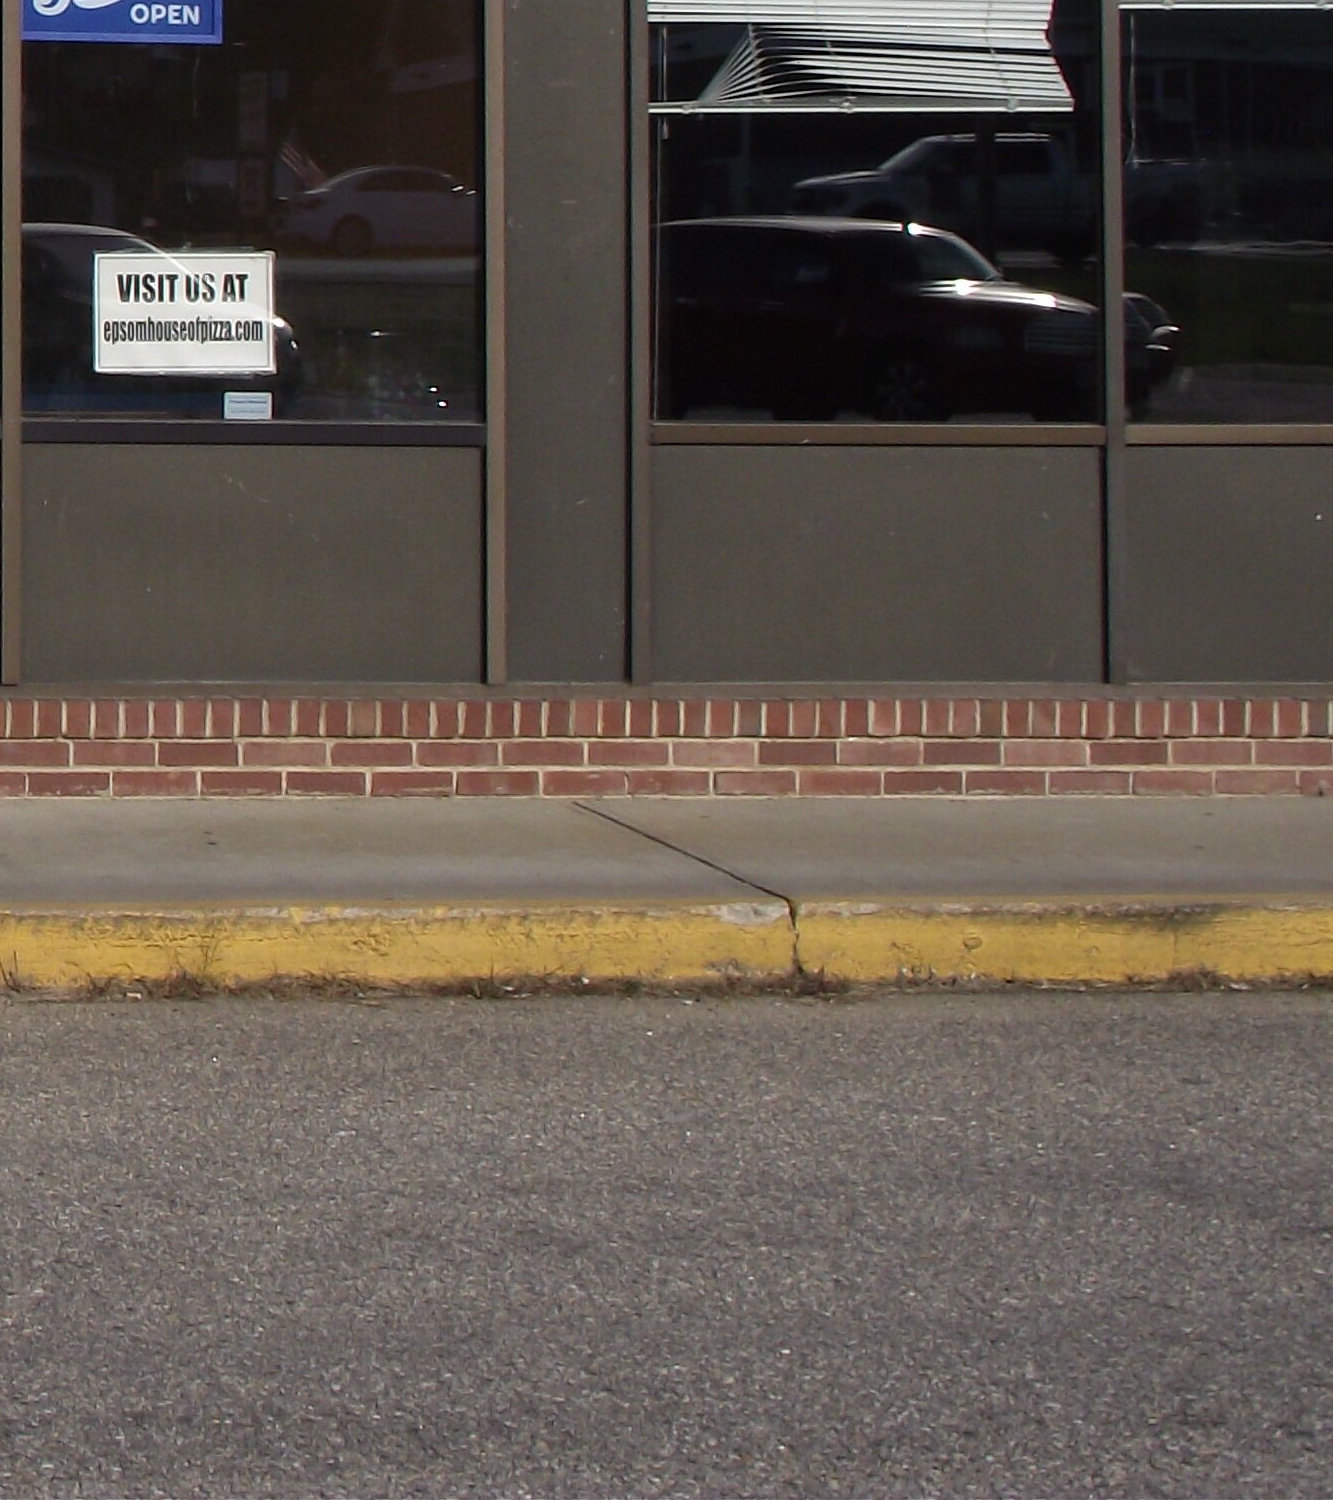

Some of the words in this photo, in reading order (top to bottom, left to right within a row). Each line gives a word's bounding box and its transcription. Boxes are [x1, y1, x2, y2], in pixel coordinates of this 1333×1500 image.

[130, 3, 201, 25] OPEN
[116, 273, 179, 303] VISIT
[185, 273, 216, 303] US
[221, 273, 249, 303] AT
[103, 315, 264, 345] epsomhouseofpizza.com
